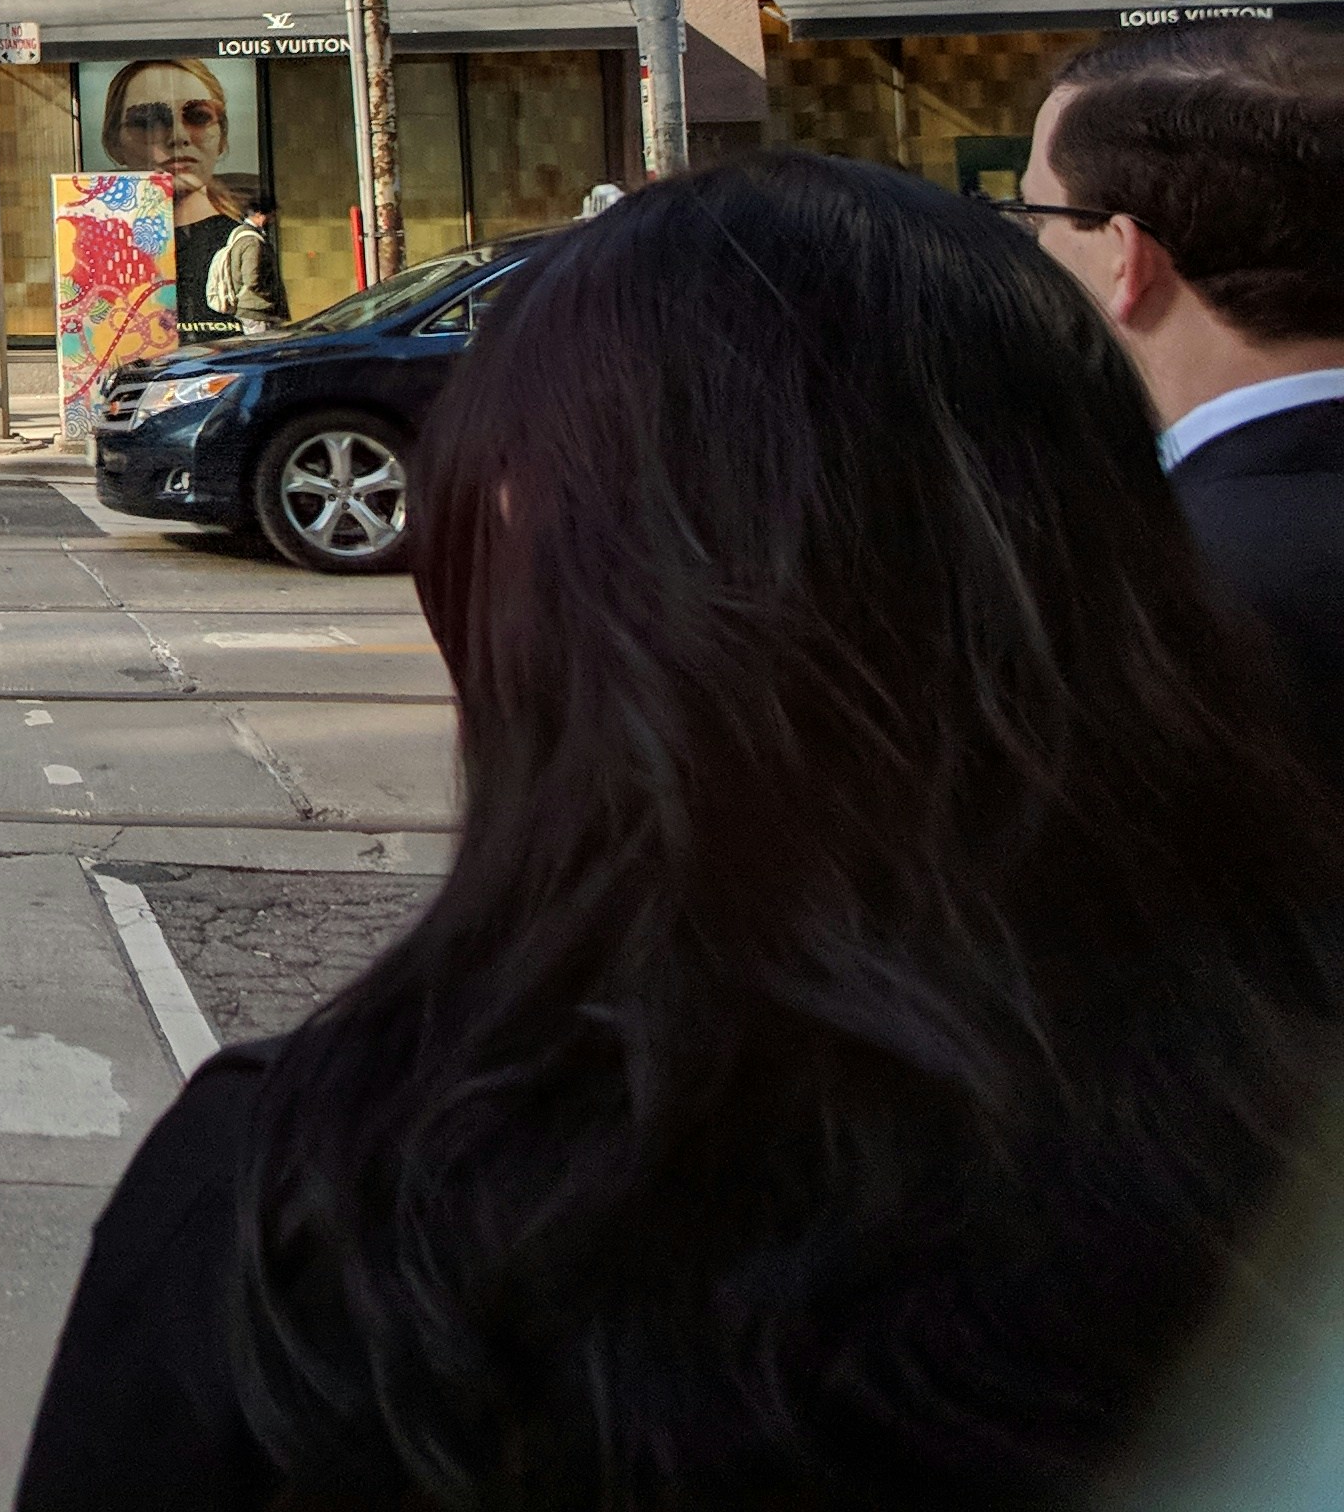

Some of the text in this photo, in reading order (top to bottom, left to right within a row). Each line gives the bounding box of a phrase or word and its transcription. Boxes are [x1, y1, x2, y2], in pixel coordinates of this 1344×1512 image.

[1119, 9, 1180, 27] LOUIS
[11, 26, 22, 37] NO
[0, 38, 36, 49] STANDING
[218, 38, 351, 56] LOUIS VUITTON
